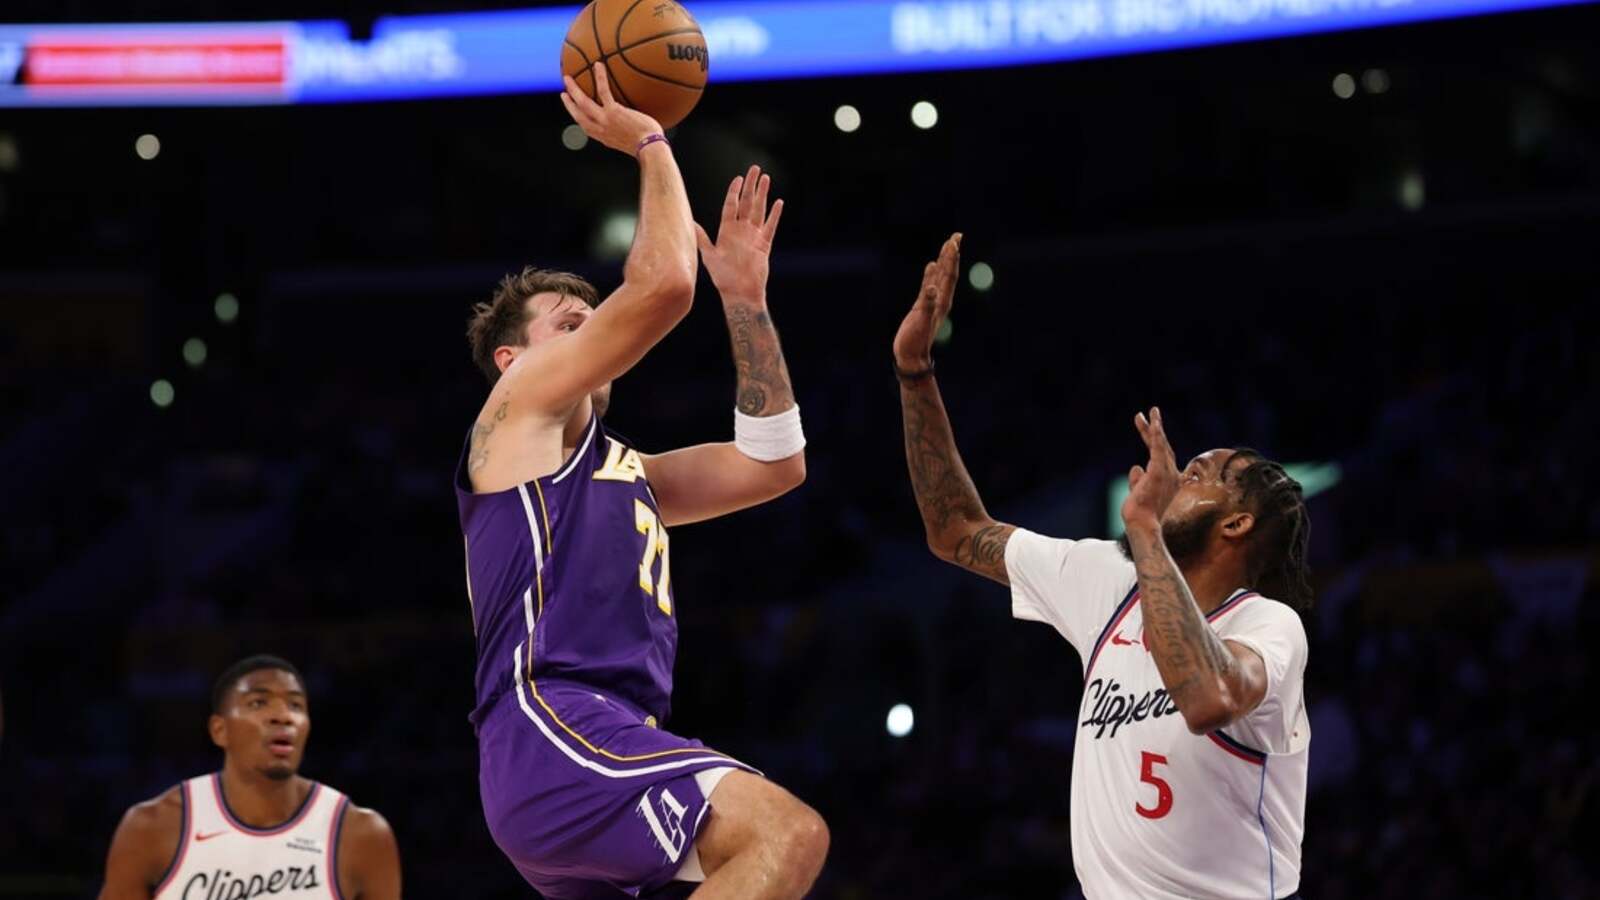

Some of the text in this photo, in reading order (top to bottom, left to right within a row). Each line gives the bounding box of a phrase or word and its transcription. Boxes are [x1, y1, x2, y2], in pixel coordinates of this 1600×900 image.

[634, 498, 671, 616] 77
[1135, 750, 1174, 820] 5
[181, 864, 319, 900] Clippers
